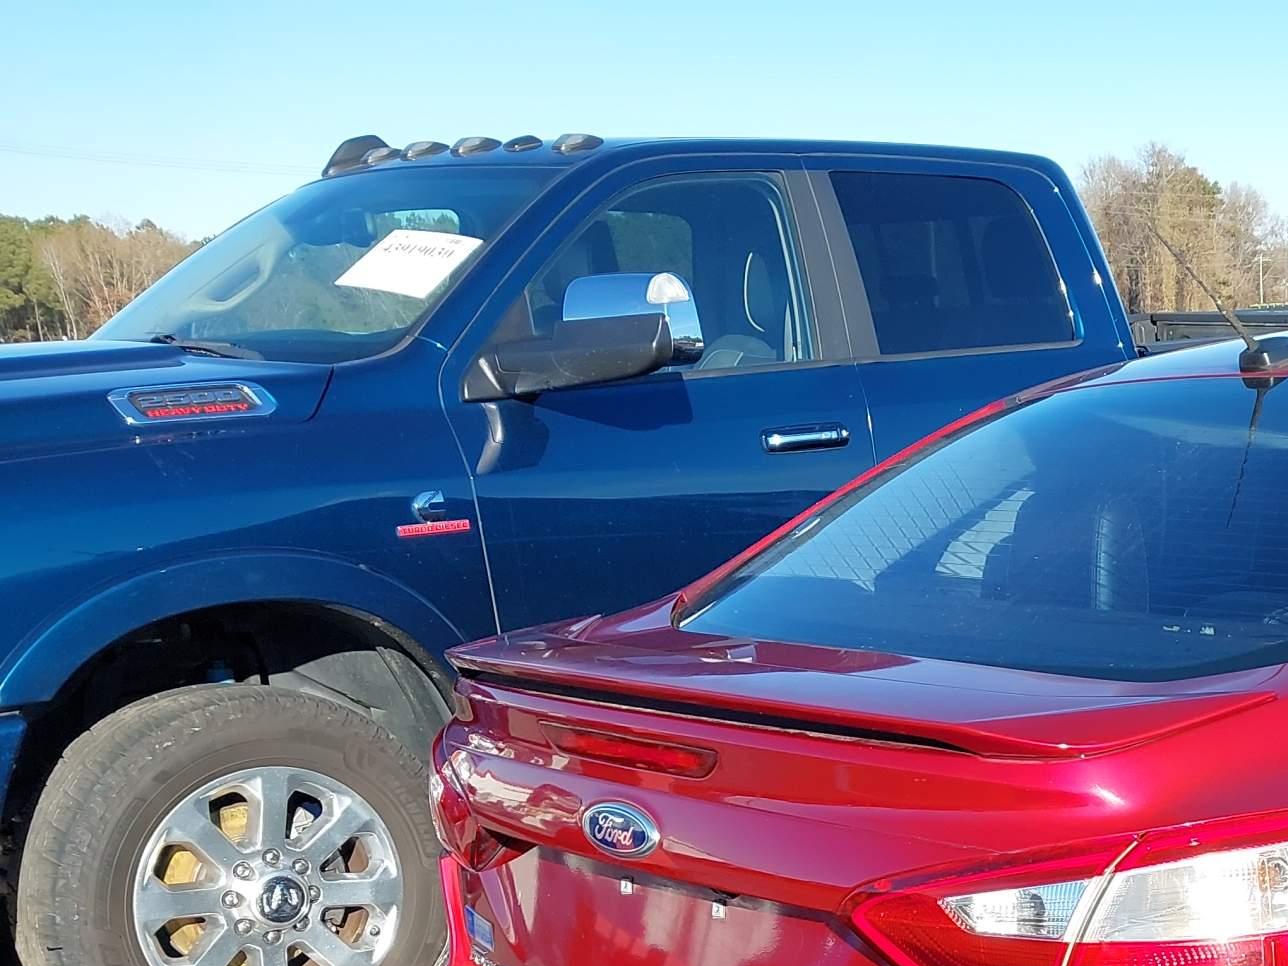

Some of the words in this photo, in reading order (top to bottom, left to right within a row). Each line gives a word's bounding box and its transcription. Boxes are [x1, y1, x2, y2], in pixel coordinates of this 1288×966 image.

[137, 388, 241, 408] 2500
[146, 405, 203, 418] HEAVY
[203, 401, 249, 414] DUTY
[594, 812, 635, 846] Ford
